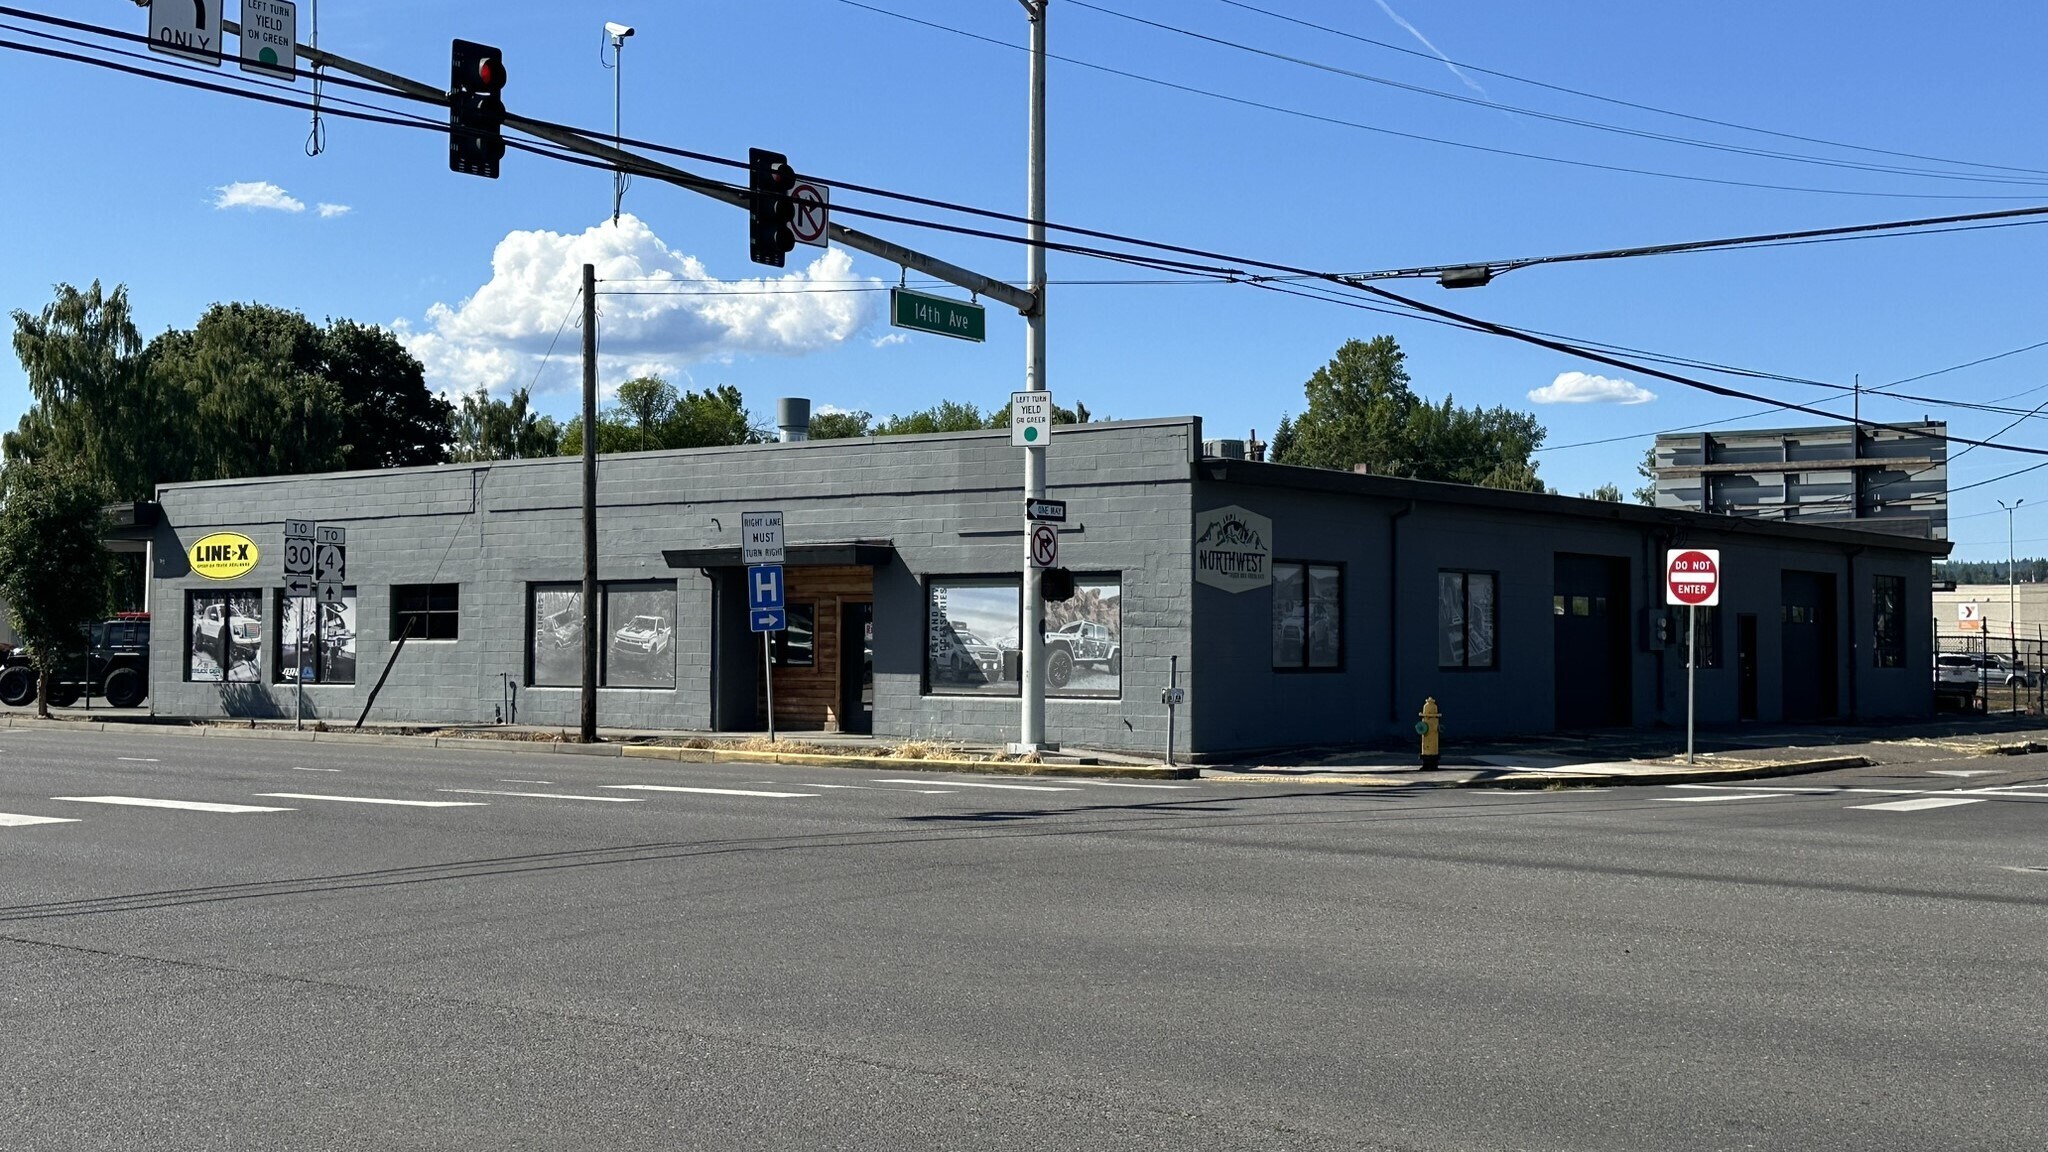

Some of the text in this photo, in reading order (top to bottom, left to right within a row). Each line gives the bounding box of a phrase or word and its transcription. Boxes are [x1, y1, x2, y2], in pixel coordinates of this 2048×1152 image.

[248, 0, 290, 17] LEFT TURN
[255, 14, 283, 31] YIELD
[247, 29, 289, 47] ON GREEN
[915, 302, 969, 329] 14th Ave
[1021, 405, 1042, 414] YIELD
[1038, 505, 1050, 514] ONE
[293, 523, 307, 534] TO
[744, 518, 781, 527] RIGHT LANE
[324, 530, 338, 541] TO
[753, 532, 774, 543] MUST
[288, 545, 311, 565] 30
[746, 547, 783, 558] TURN RIGHT
[325, 551, 334, 569] 4
[1200, 550, 1265, 574] NORTHWEST
[1675, 561, 1711, 570] DO NOT
[755, 572, 777, 603] H
[1678, 584, 1707, 594] ENTER
[931, 611, 939, 632] AND
